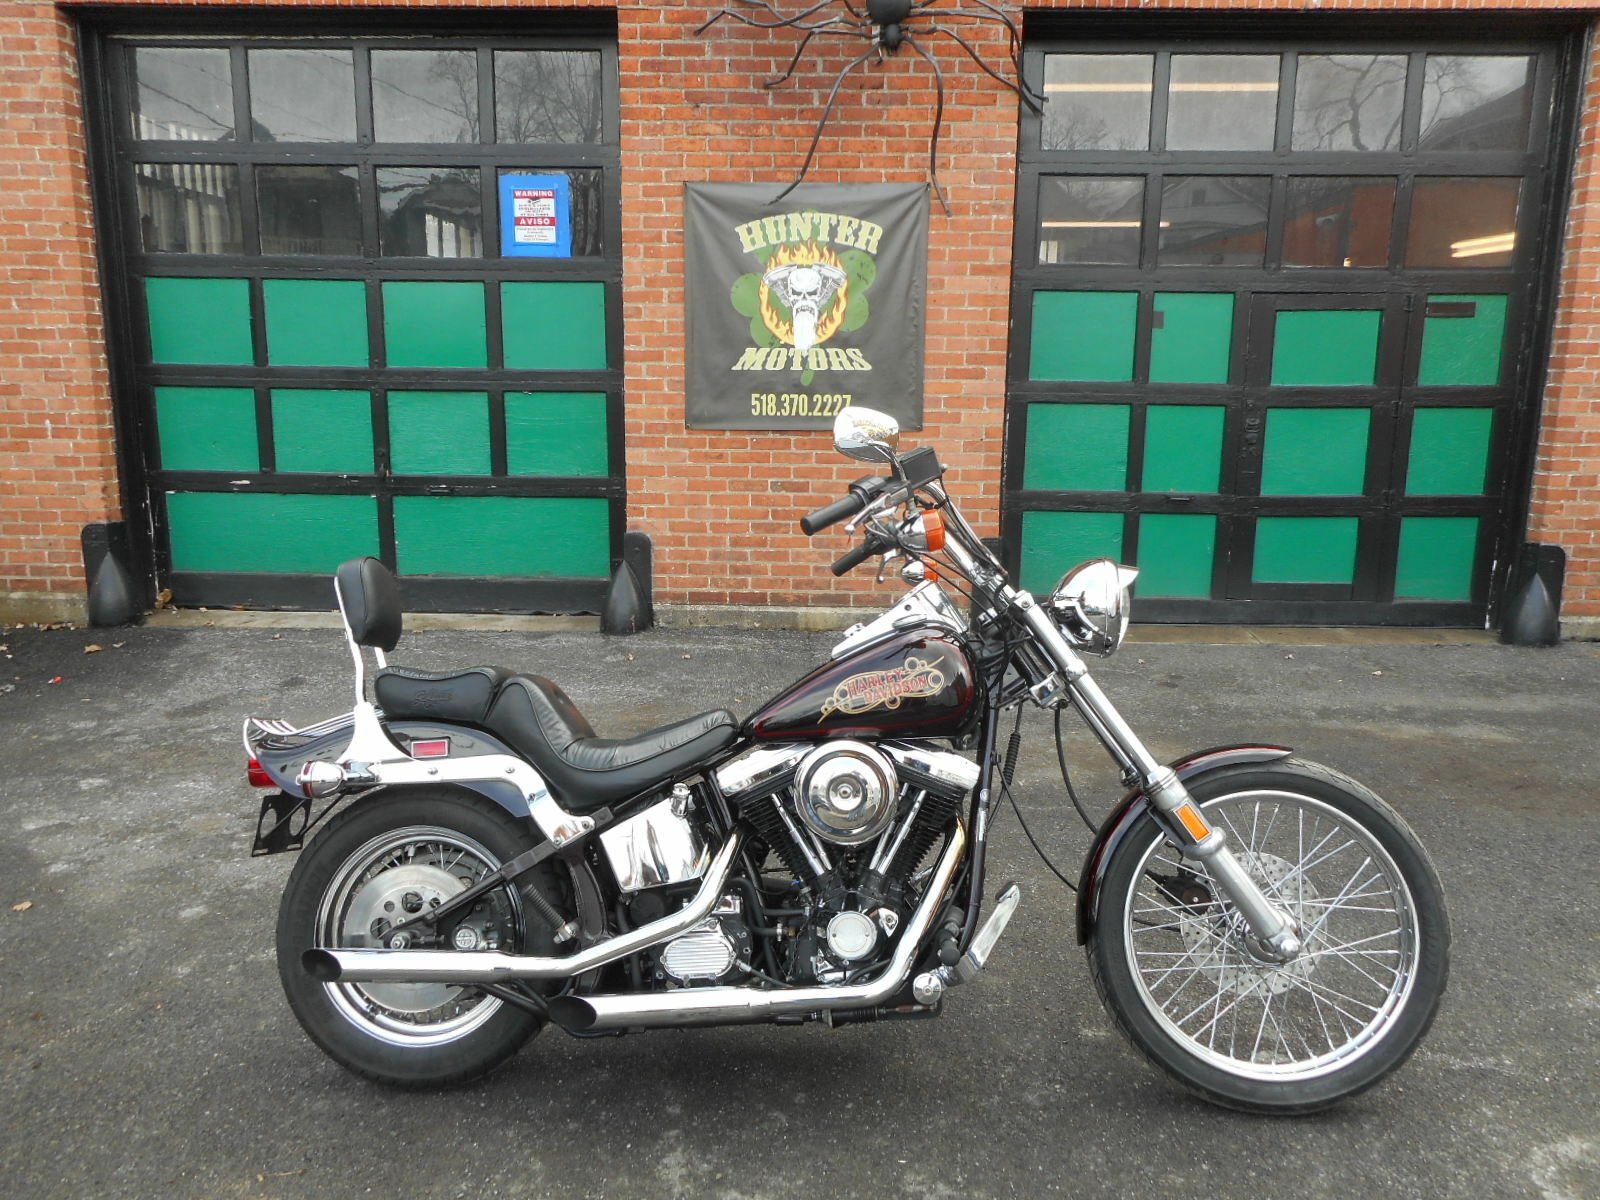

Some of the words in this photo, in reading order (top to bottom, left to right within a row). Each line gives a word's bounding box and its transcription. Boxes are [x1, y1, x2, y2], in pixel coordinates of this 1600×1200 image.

[734, 212, 883, 254] HUNTER
[731, 348, 872, 371] MOTORS
[863, 675, 929, 703] DAVIDSON
